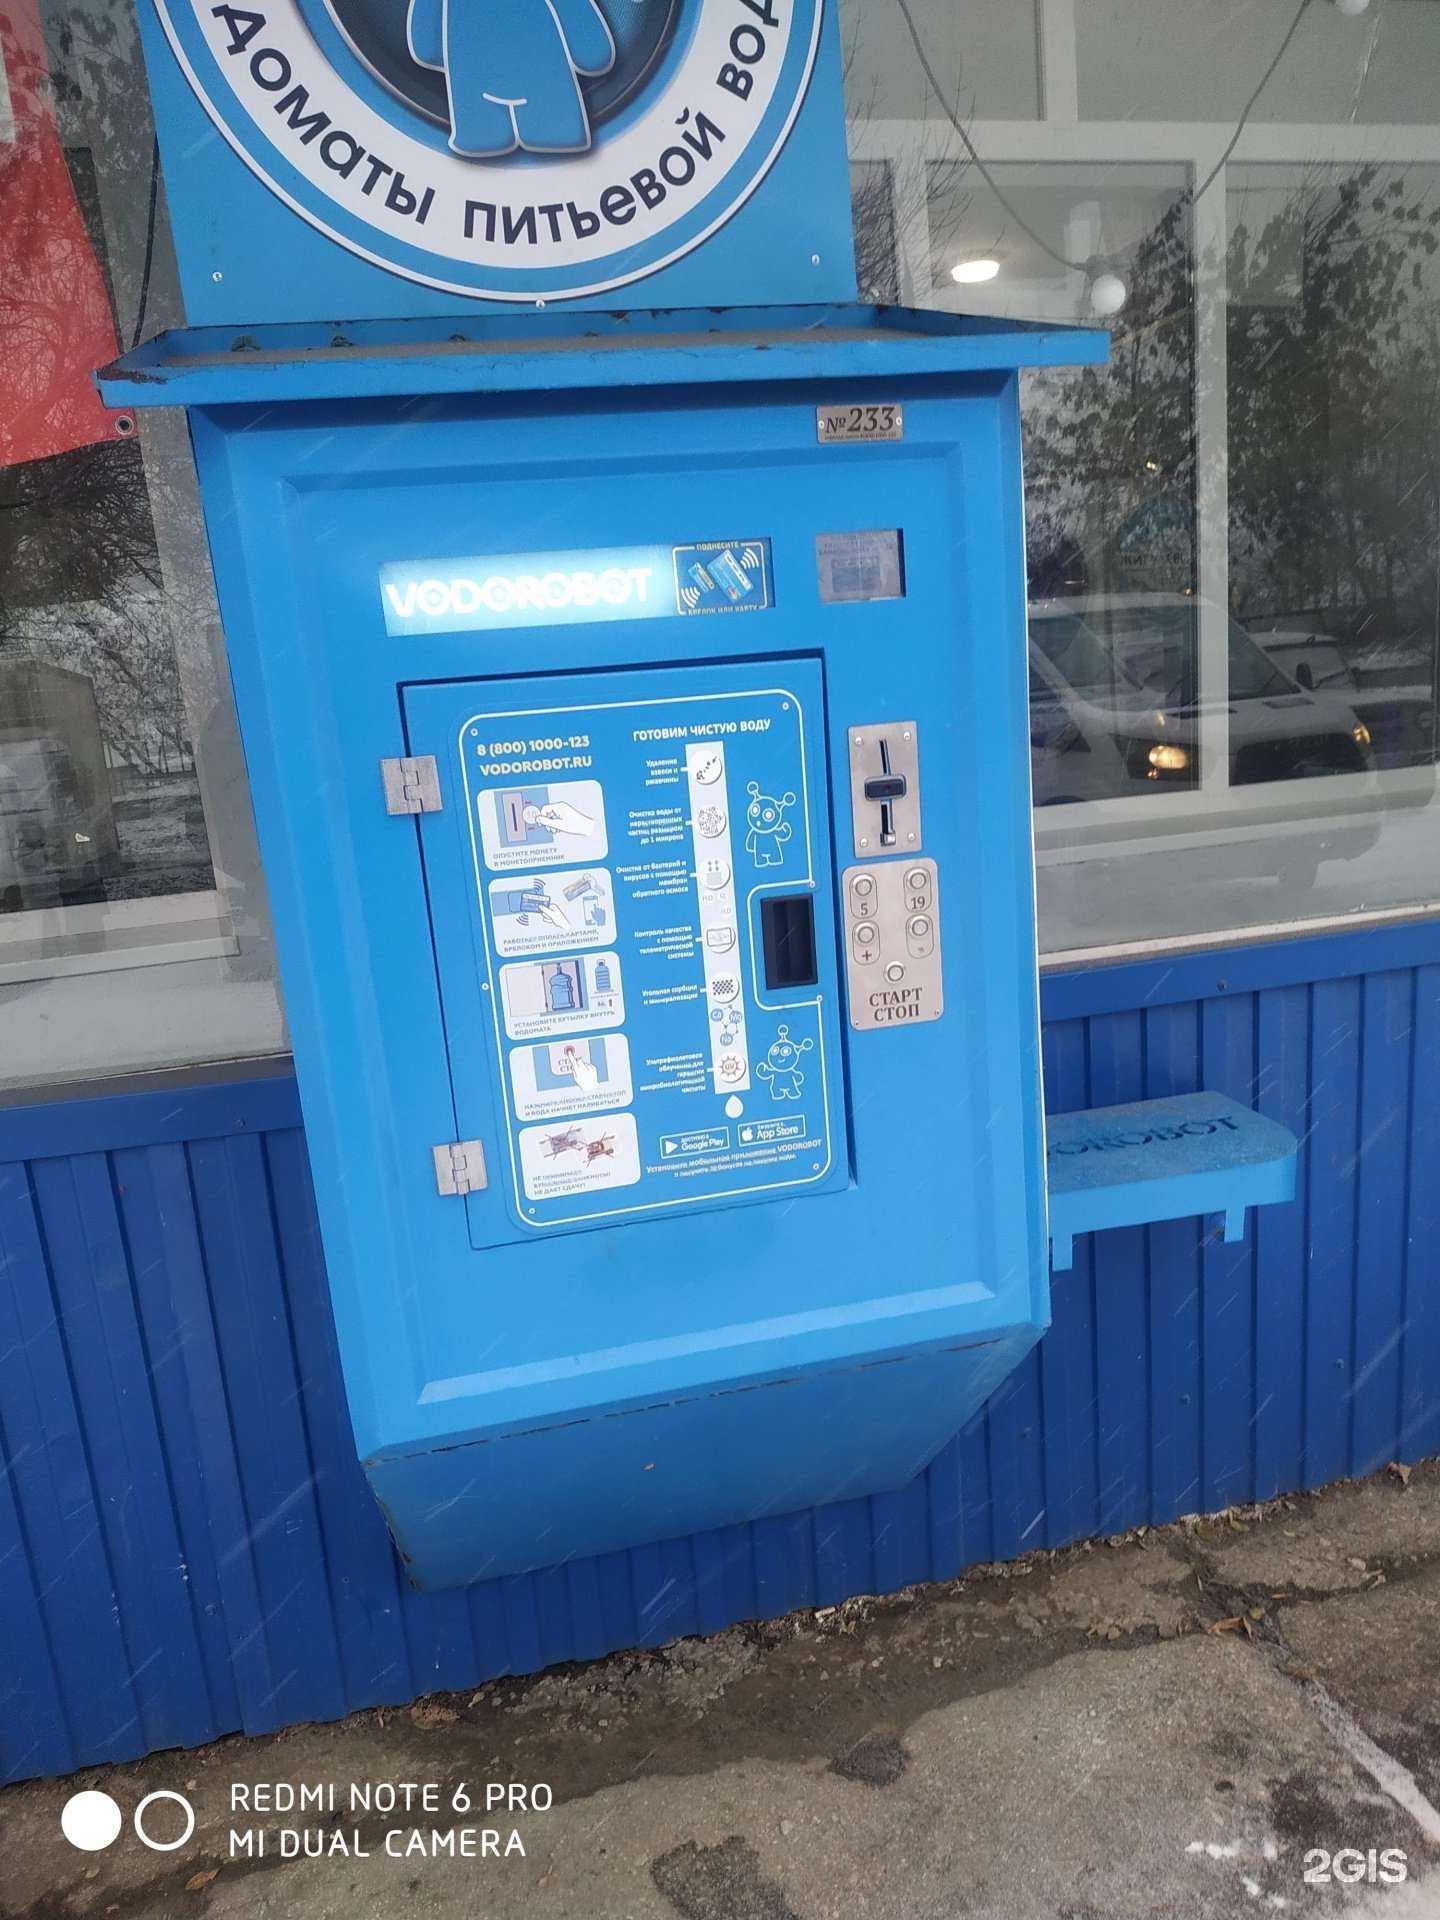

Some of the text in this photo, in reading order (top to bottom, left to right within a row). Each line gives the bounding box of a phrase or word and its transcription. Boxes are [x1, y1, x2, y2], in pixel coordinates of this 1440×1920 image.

[386, 567, 652, 618] VODOROBOT
[633, 718, 771, 742] ГОТОВИМ ЧИСТУЮ ВОДУ
[476, 735, 590, 758] 8 (800) 1000-123
[480, 755, 592, 777] VODOROBOT.RU
[628, 811, 656, 819] Очистка
[656, 809, 674, 817] воды
[615, 865, 641, 874] Очистка
[860, 902, 868, 916] 5
[911, 896, 925, 910] 19
[869, 987, 923, 1007] СТАРТ
[874, 1003, 921, 1022] СТОП
[756, 1125, 798, 1140] App Store
[1047, 1116, 1238, 1156] OROBOT
[681, 1138, 724, 1151] Google Play
[777, 1139, 822, 1153] VODOROBOT
